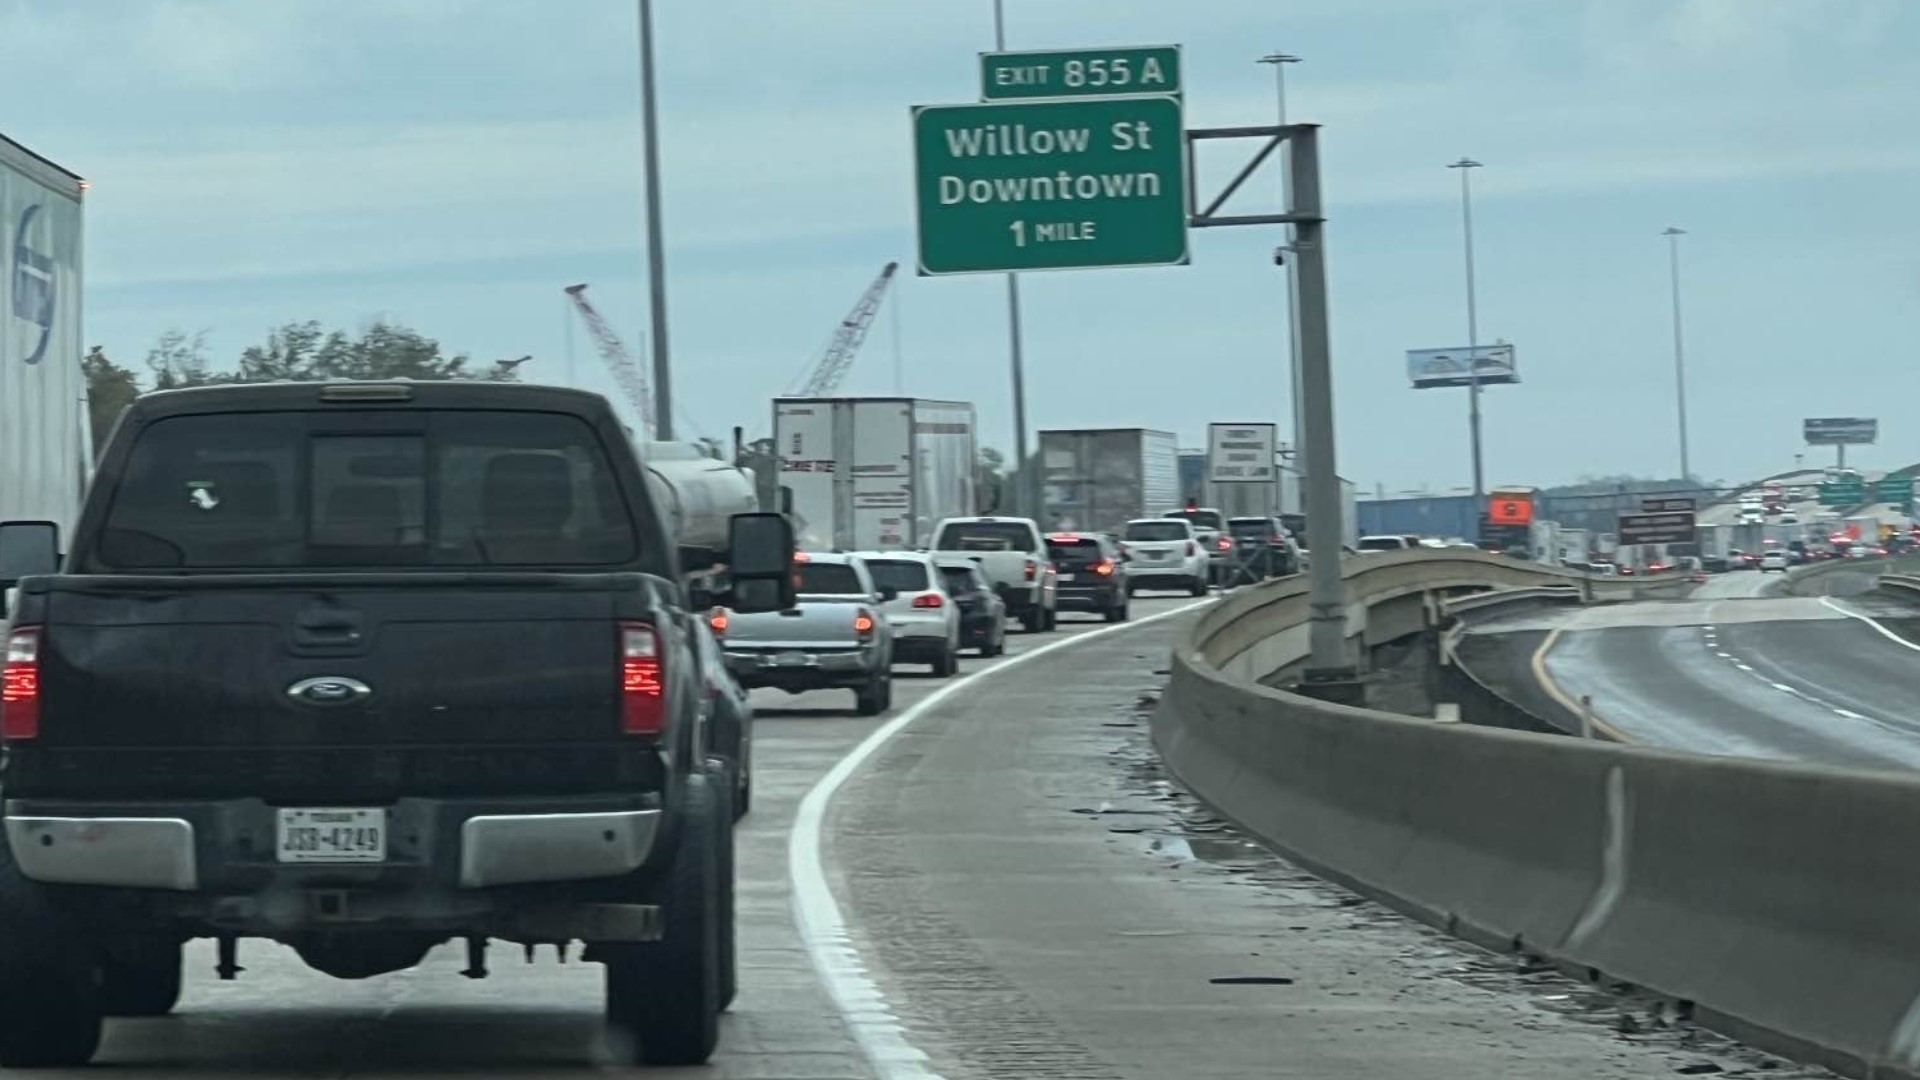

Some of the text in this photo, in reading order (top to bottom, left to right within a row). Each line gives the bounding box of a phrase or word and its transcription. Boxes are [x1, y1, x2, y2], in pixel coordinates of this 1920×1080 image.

[996, 57, 1165, 87] EXIT 855 A
[945, 120, 1152, 157] Willow St
[939, 171, 1160, 205] Downtown
[1008, 220, 1096, 247] 1 MILE
